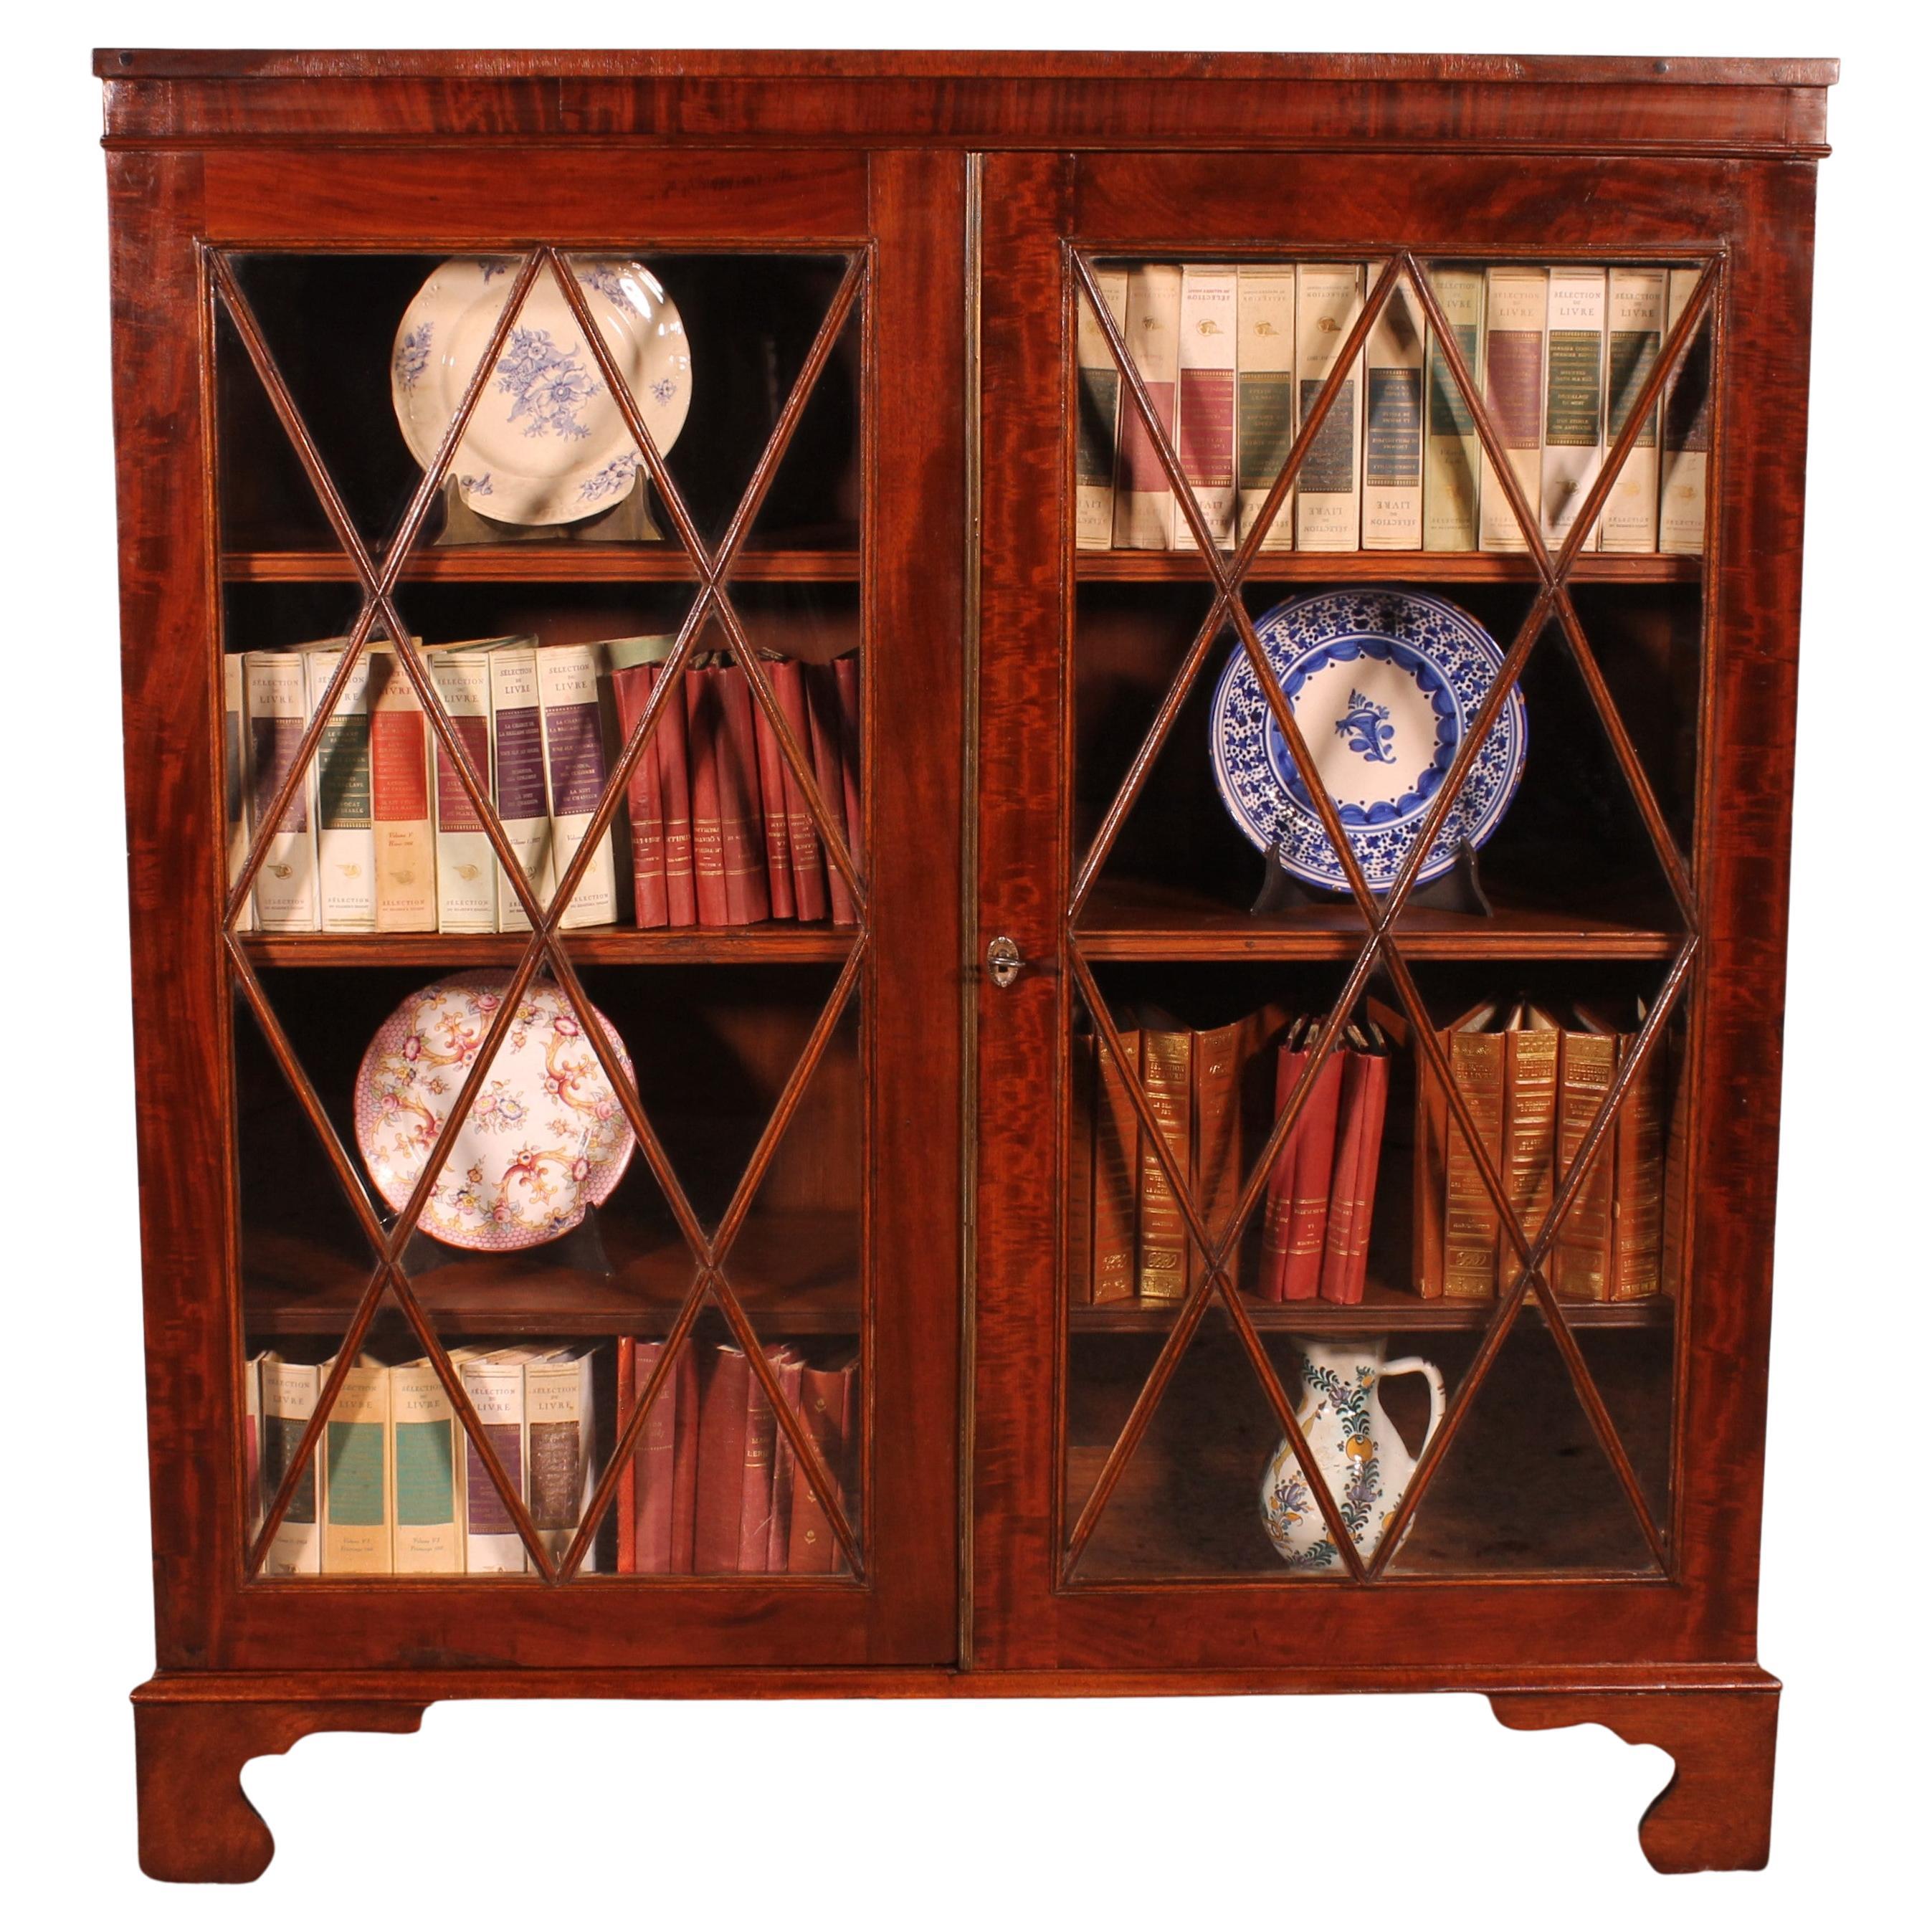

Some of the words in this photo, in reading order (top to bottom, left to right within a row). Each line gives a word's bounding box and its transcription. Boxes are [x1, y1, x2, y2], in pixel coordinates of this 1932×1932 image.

[1376, 500, 1411, 510] LIVRE
[1308, 507, 1343, 515] LIVRE
[500, 667, 533, 677] SÉLECTION
[548, 663, 590, 675] SÉLECTION
[505, 684, 531, 695] LIVRE
[555, 680, 588, 691] LIVRE
[260, 695, 293, 704] LIVRE
[444, 694, 479, 703] LIVRE
[267, 1379, 310, 1389] SÉLECTION
[272, 1394, 305, 1406] LIVRE
[338, 1400, 373, 1409] LIVRE
[407, 1400, 441, 1409] LIVRE
[477, 1403, 511, 1412] LIVRE
